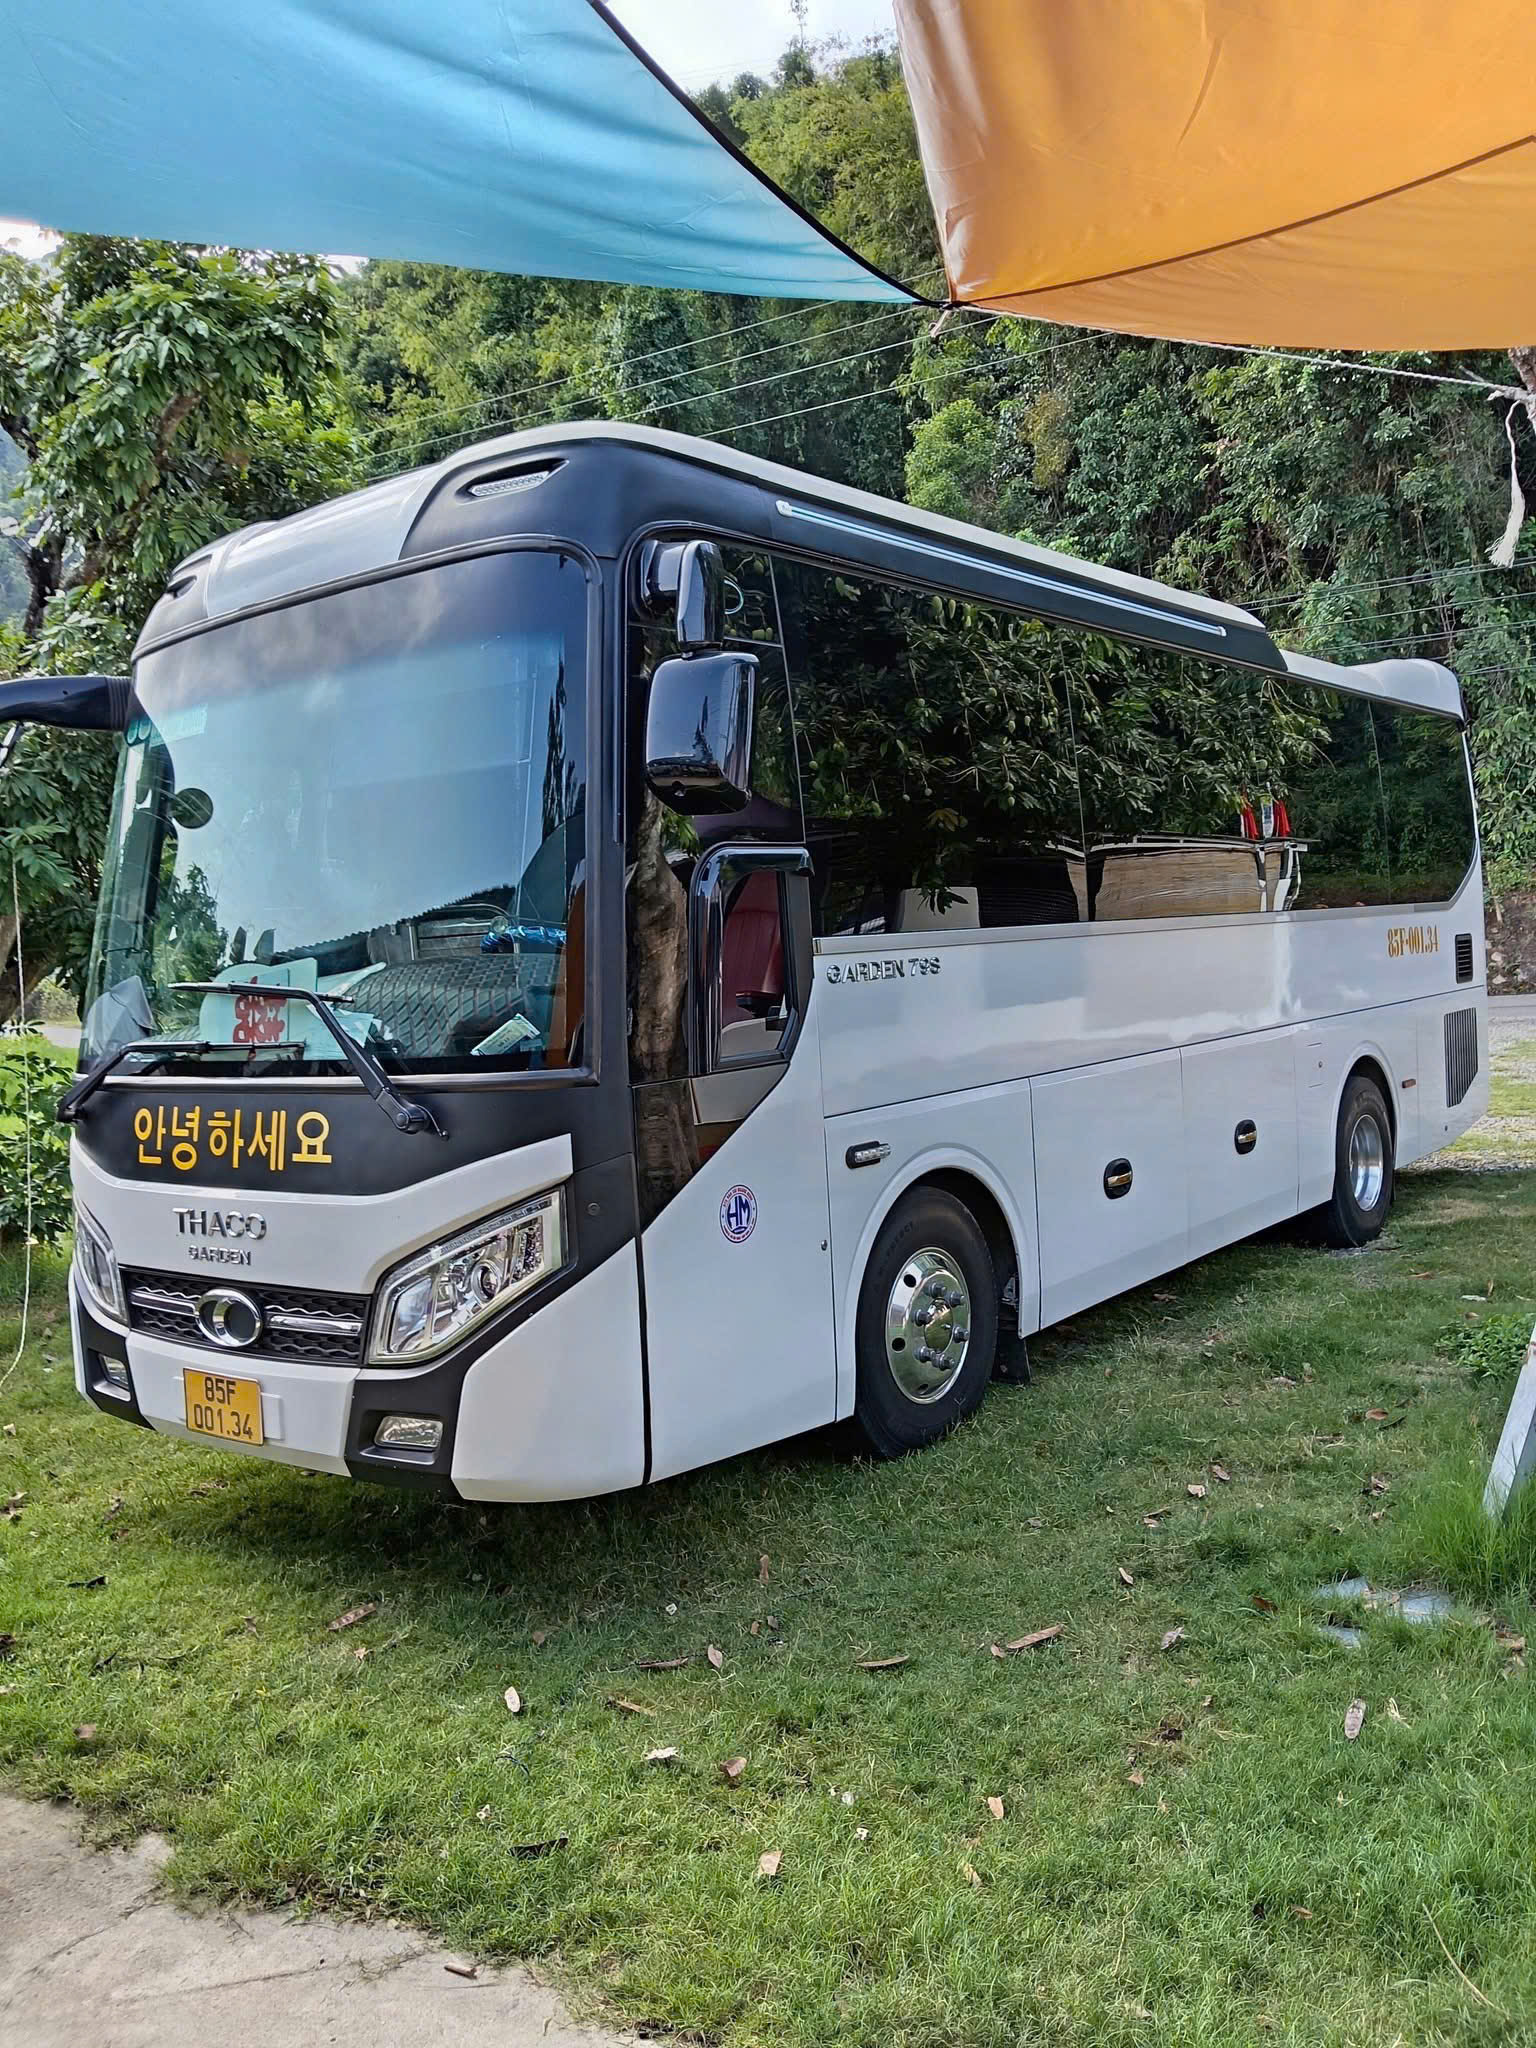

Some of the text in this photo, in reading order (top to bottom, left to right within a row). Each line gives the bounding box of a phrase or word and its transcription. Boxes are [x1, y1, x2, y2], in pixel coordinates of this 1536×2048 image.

[826, 960, 905, 984] GARDEN
[134, 1105, 332, 1171] 안녕하세요
[172, 1207, 267, 1240] THACO
[727, 1195, 751, 1230] HM
[188, 1244, 252, 1266] GARDEN
[204, 1376, 237, 1405] 85F
[193, 1403, 254, 1440] 001.34
